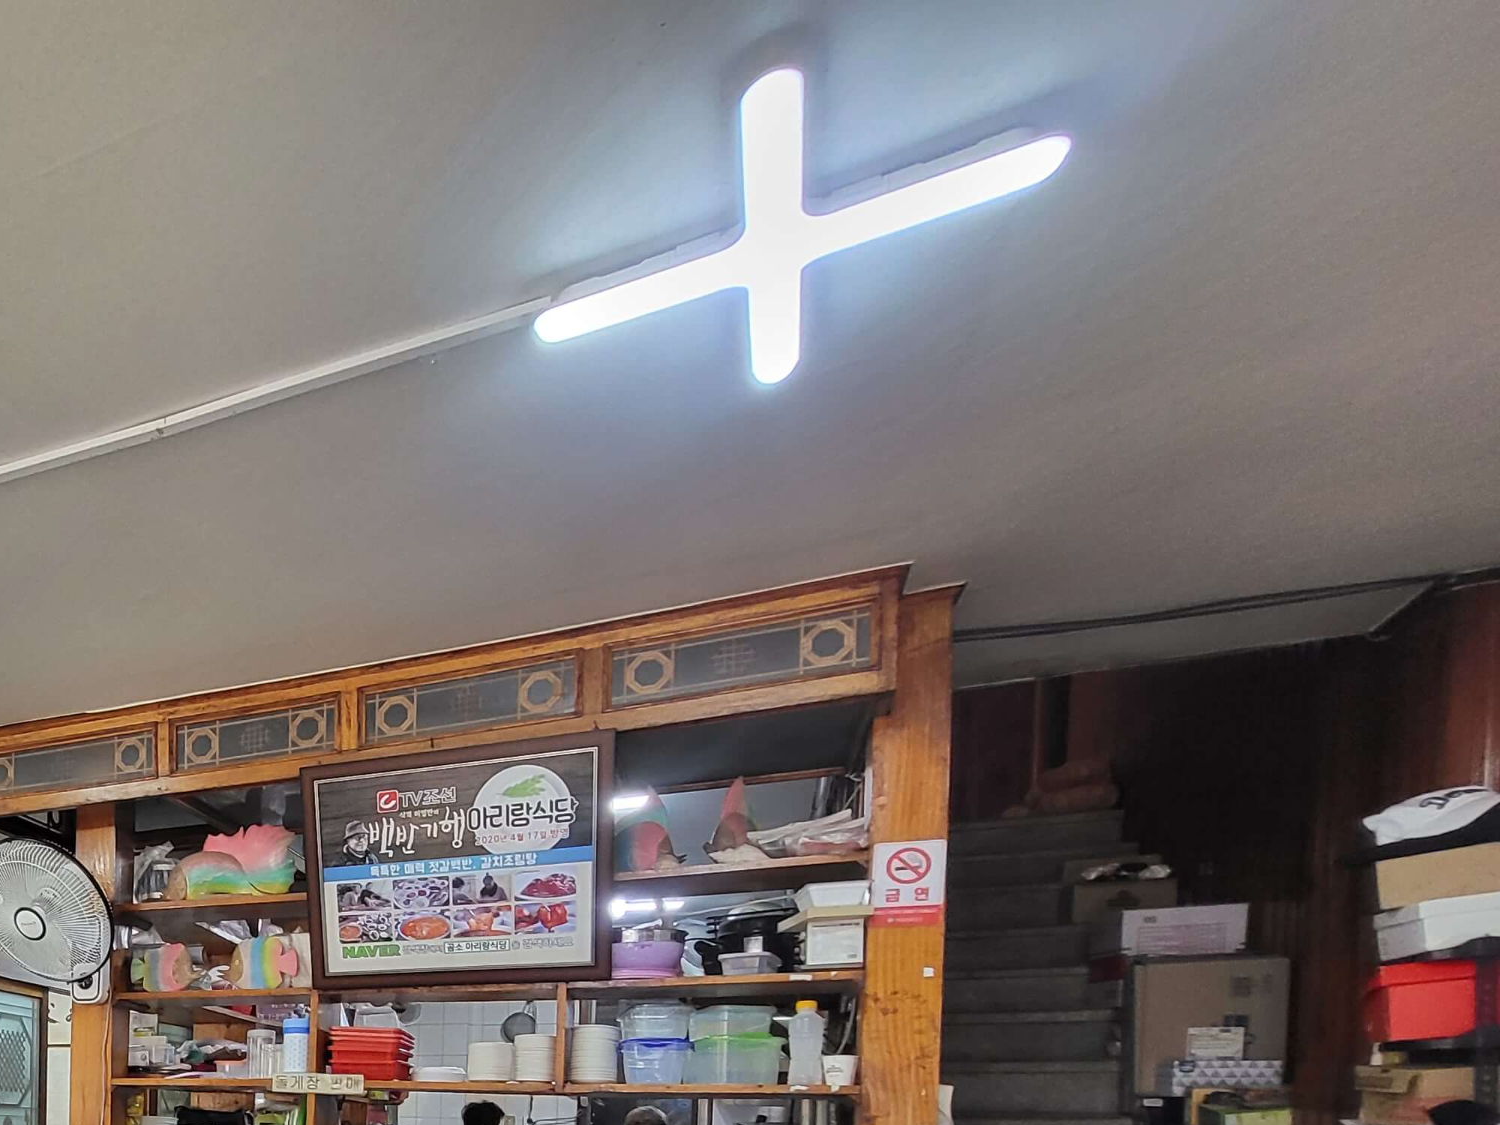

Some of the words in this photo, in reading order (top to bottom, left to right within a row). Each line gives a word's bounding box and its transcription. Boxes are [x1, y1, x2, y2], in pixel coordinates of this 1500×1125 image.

[398, 786, 456, 808] TV조선
[468, 798, 578, 831] 아리랑식당
[368, 805, 466, 858] 백반기행
[476, 834, 507, 845] 2020년
[527, 830, 547, 840] 17일
[481, 853, 537, 869] 갈치조림탕
[885, 887, 929, 903] 금연
[342, 943, 401, 959] NAVER
[465, 940, 508, 950] 아리랑식당
